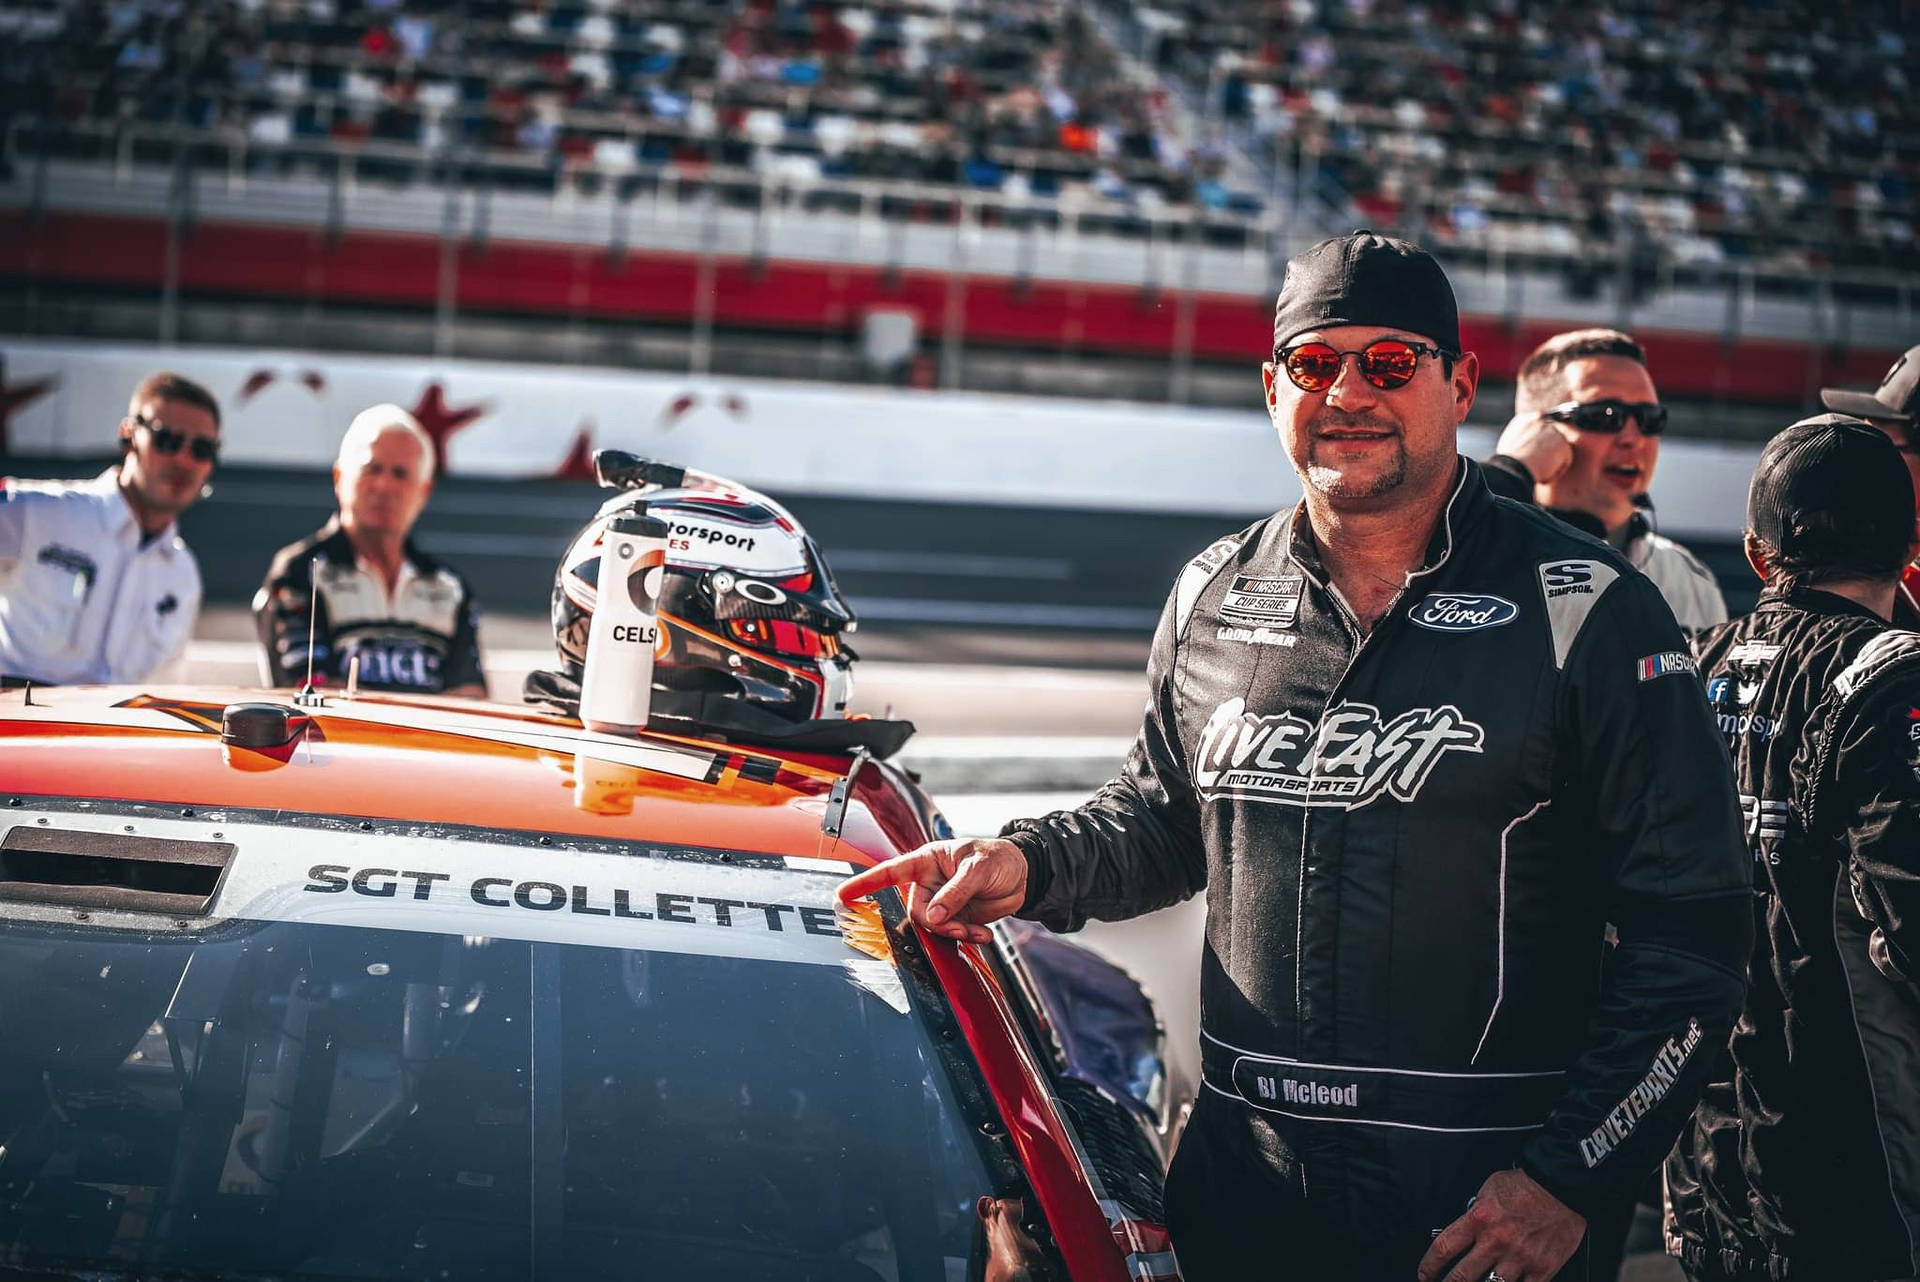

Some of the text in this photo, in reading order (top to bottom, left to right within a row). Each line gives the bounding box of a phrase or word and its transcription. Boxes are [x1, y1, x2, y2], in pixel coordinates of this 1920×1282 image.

[1235, 597, 1289, 610] CUP SERIES
[1424, 596, 1497, 625] Ford
[1227, 773, 1359, 793] MOTORSPORTS
[302, 864, 844, 938] SGT COLLETTE
[1257, 1075, 1358, 1107] BJ Mcleod
